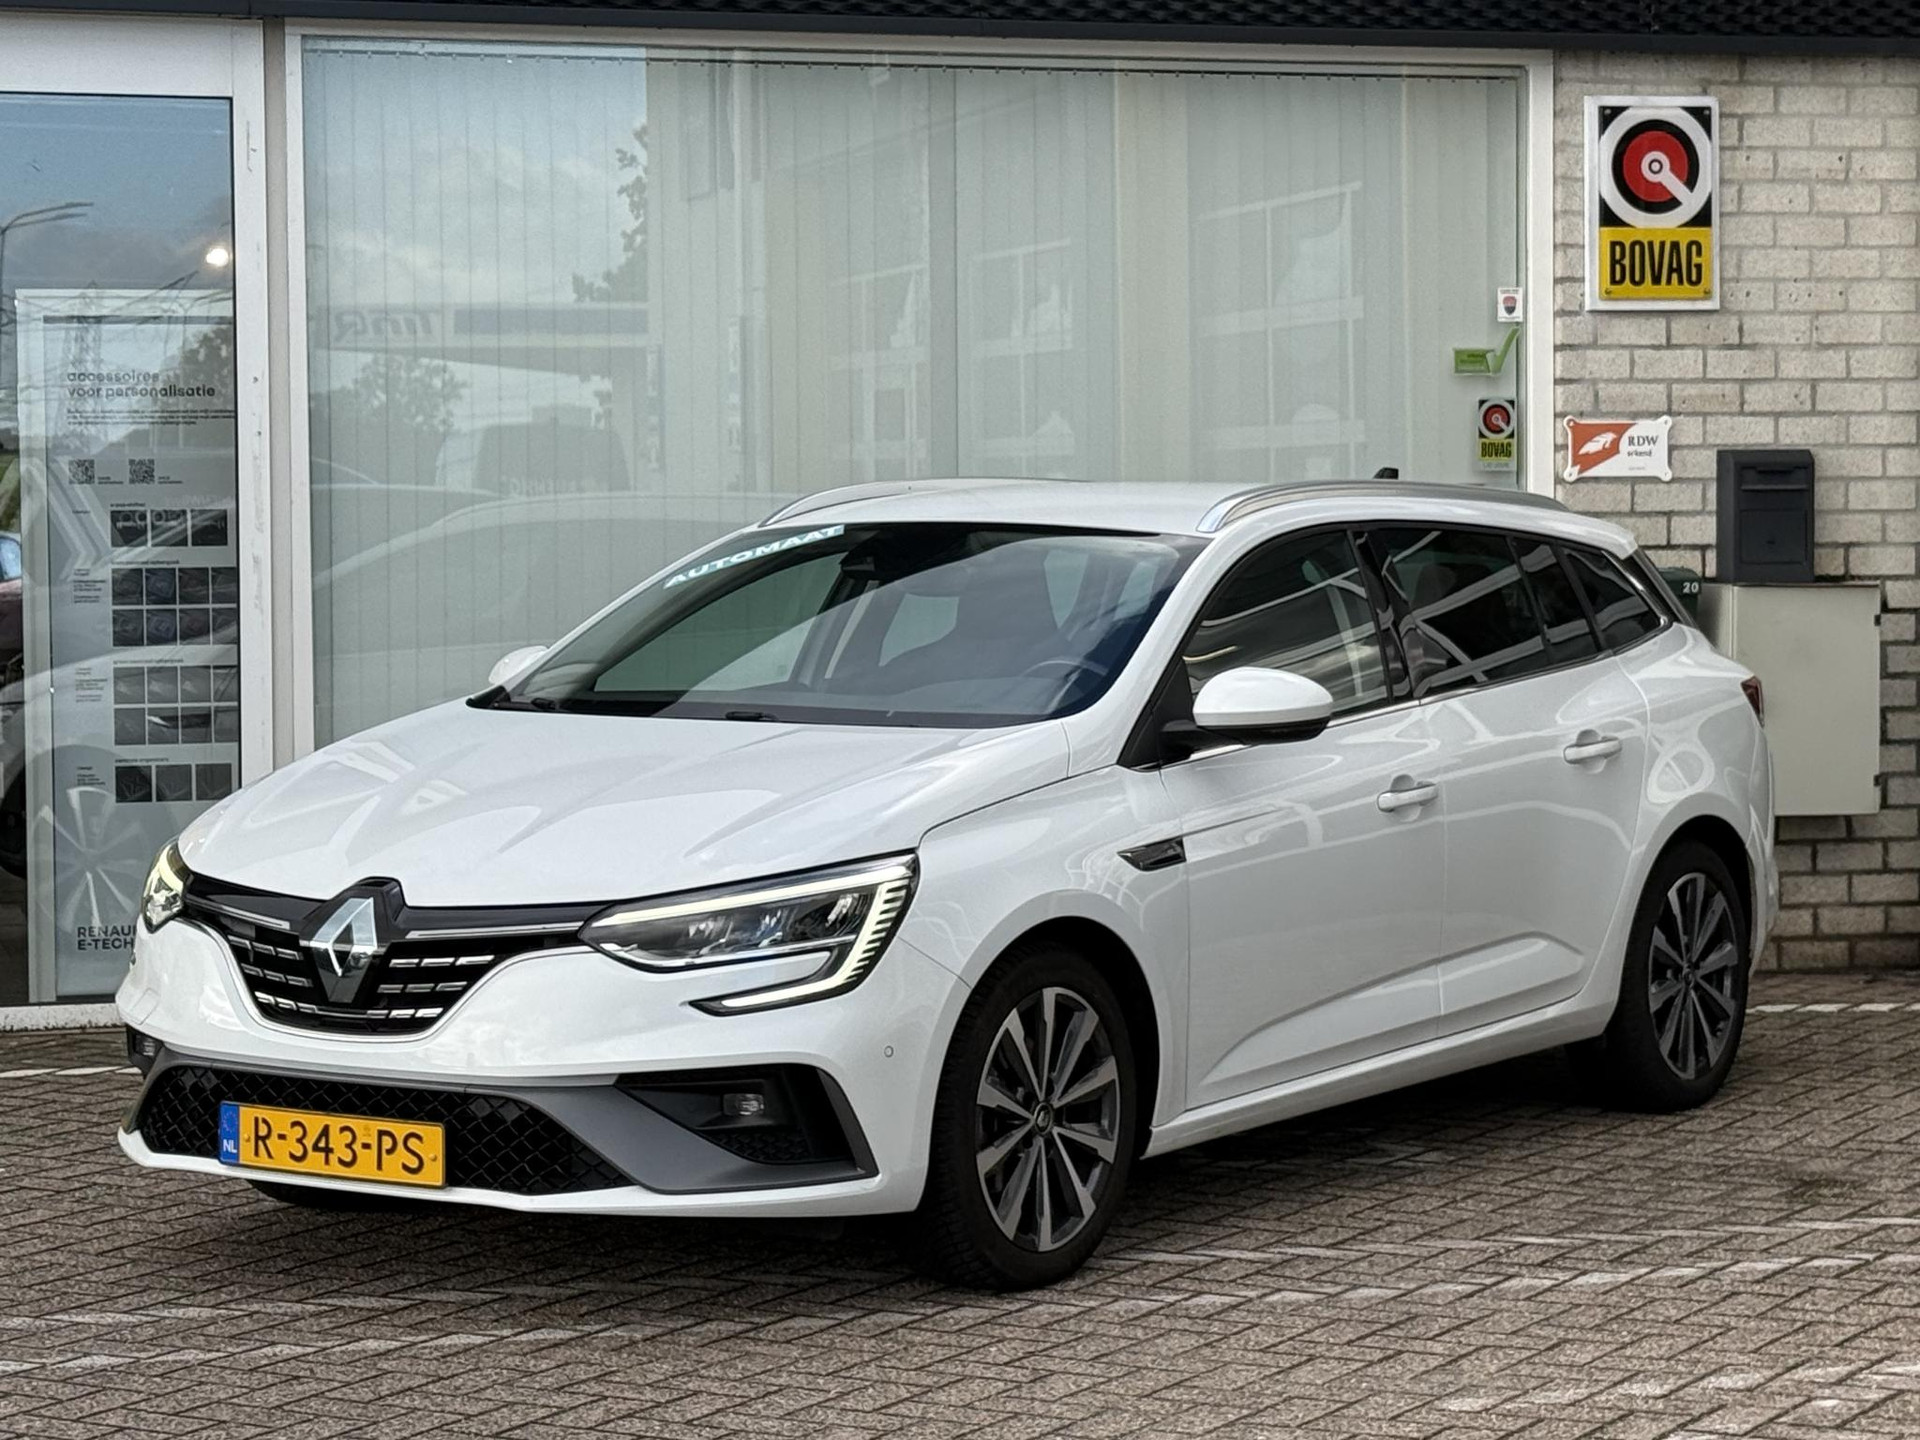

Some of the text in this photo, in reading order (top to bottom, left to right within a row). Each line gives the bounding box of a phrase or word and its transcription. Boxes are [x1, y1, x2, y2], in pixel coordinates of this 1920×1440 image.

[1609, 240, 1703, 287] BOVAG
[67, 370, 160, 382] accessoires
[67, 384, 216, 400] voor personalisatie
[1628, 435, 1659, 446] RDW
[1481, 441, 1512, 458] BOVAG
[663, 524, 845, 589] AUTOMAAT
[1682, 581, 1699, 593] 20
[77, 938, 134, 950] E-TECH
[222, 1138, 238, 1153] NL
[253, 1116, 425, 1176] R-343-PS
